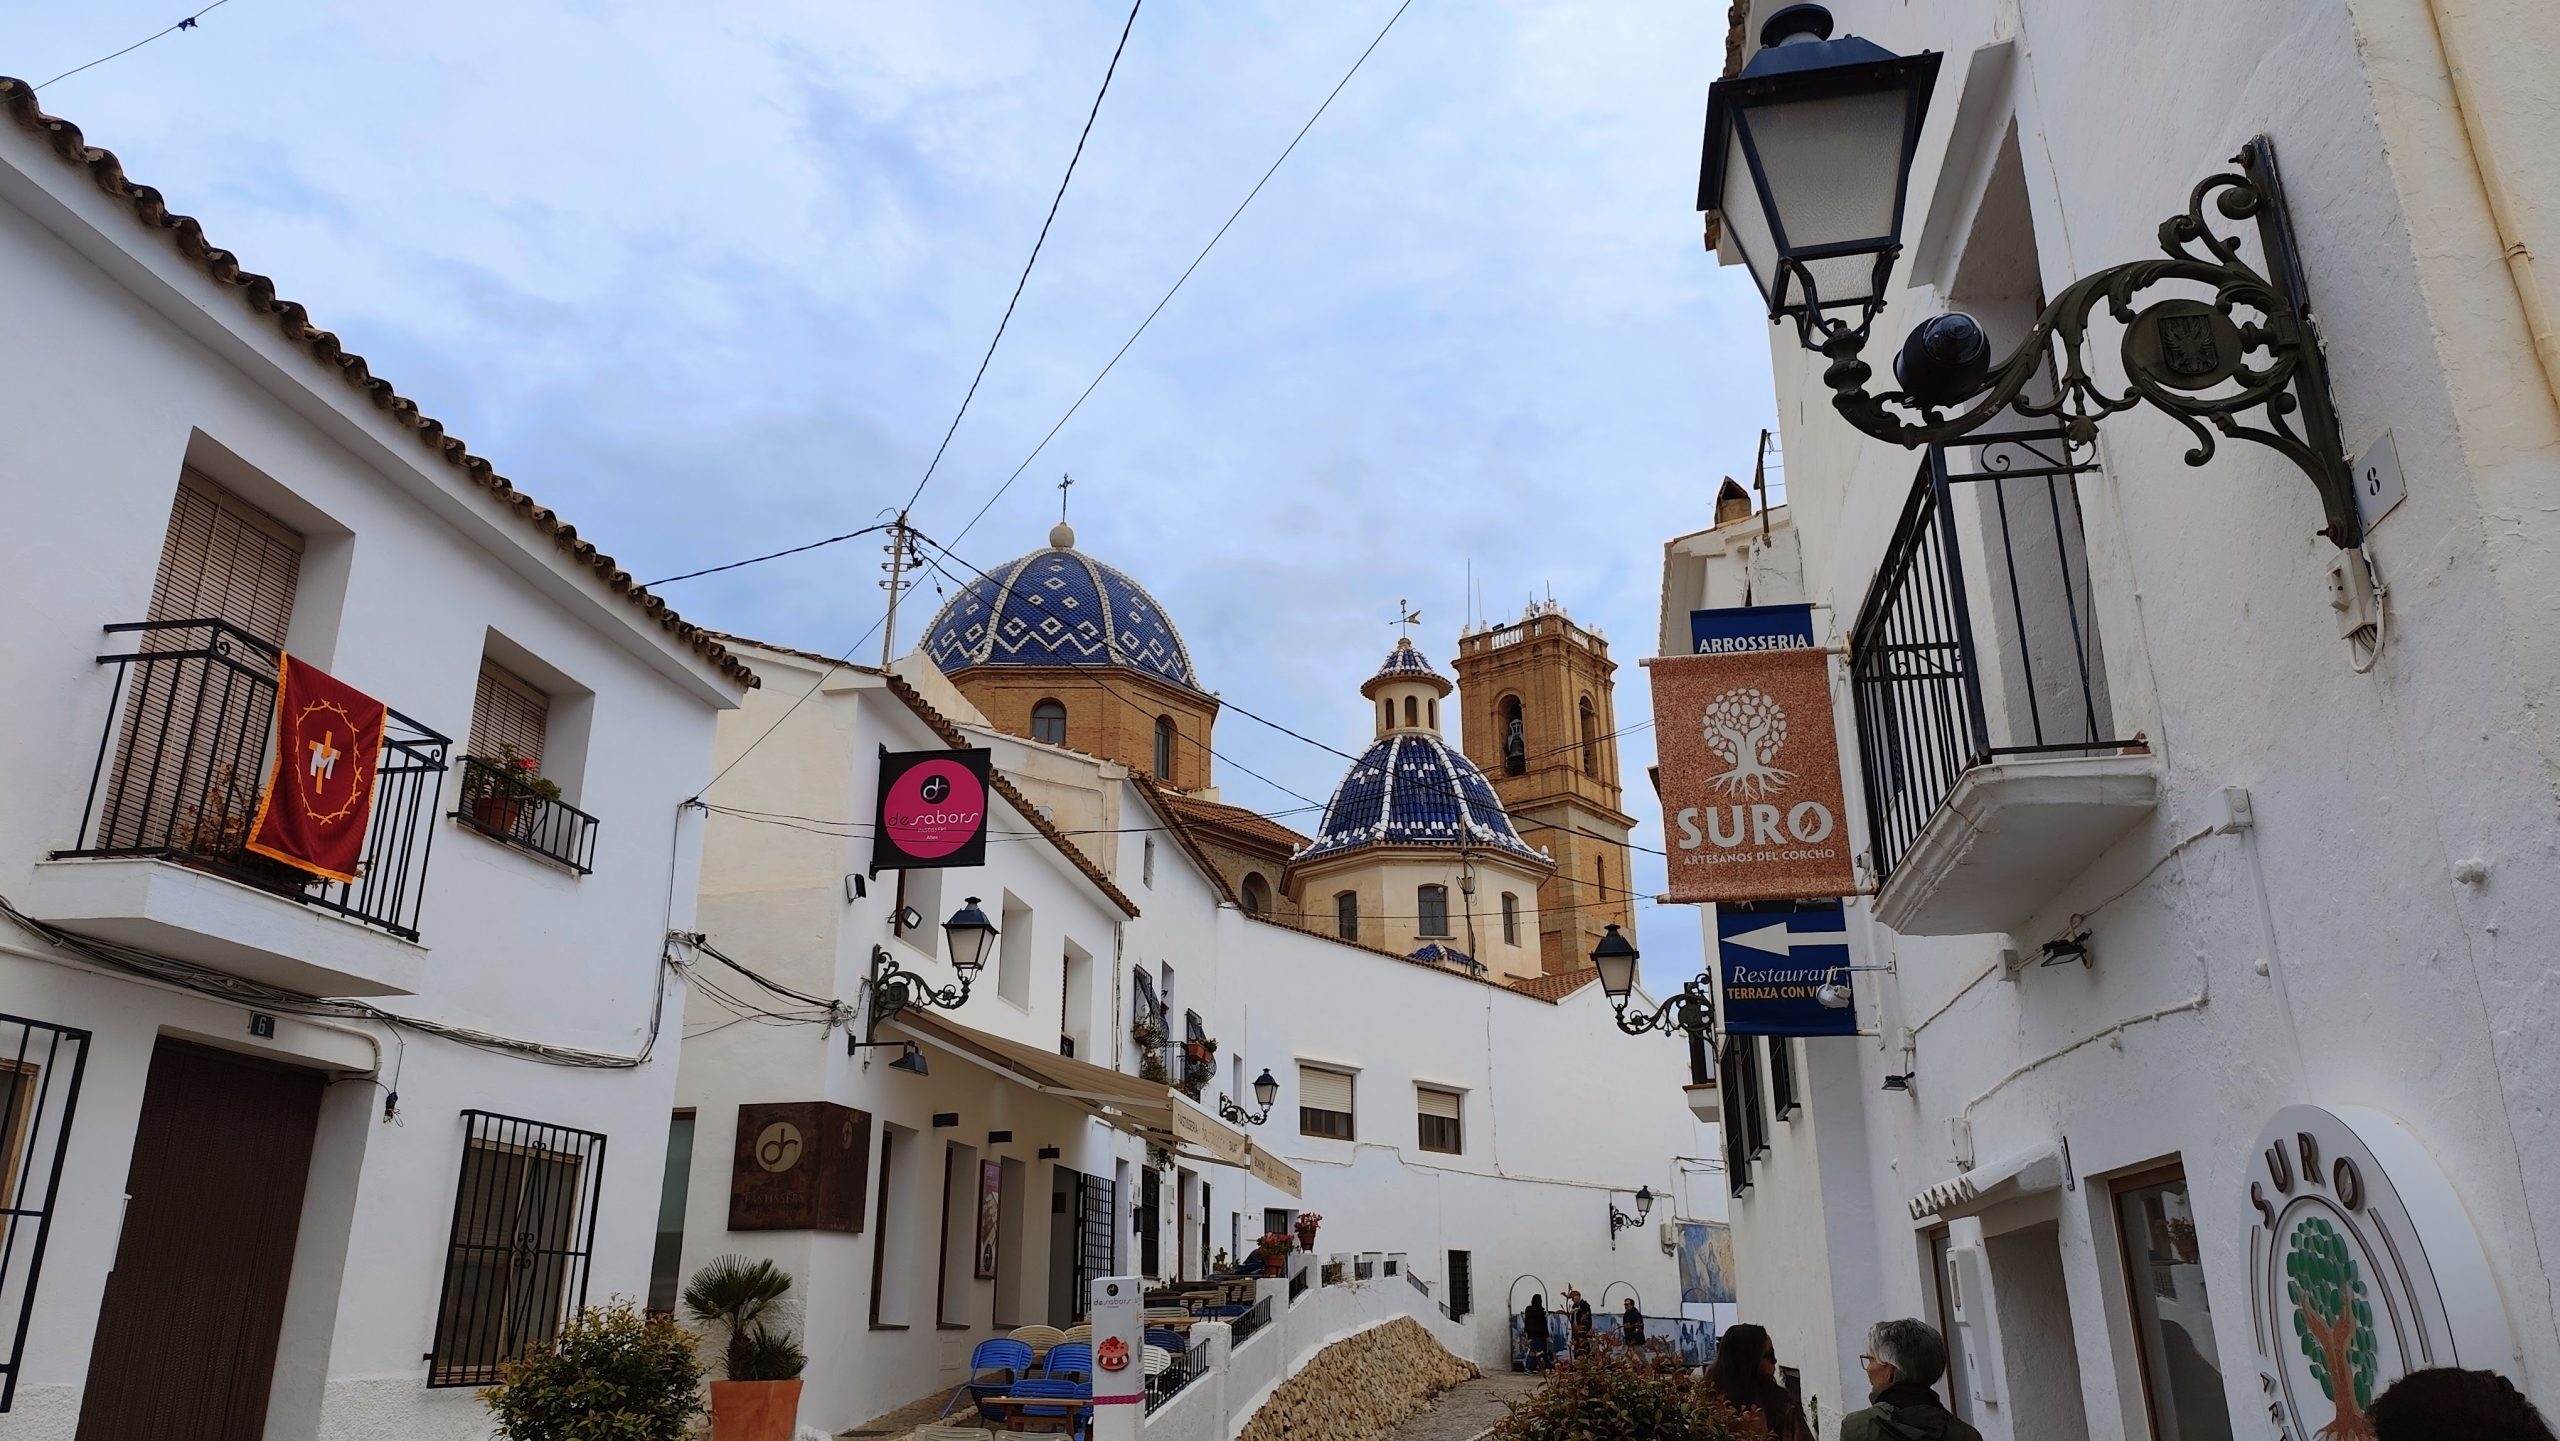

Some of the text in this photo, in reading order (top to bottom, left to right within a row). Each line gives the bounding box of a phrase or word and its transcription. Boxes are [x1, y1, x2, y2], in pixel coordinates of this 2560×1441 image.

[2367, 467, 2380, 496] 8
[1698, 633, 1809, 653] ARROSSERIA
[1677, 801, 1833, 850] SURO
[1683, 849, 1835, 865] ARTESANOS DEL CORCHO
[1732, 965, 1839, 984] Restaurant
[1727, 987, 1779, 1000] TERRAZA
[1780, 986, 1805, 998] CON
[258, 1016, 267, 1034] 6
[2250, 1131, 2364, 1231] SURO
